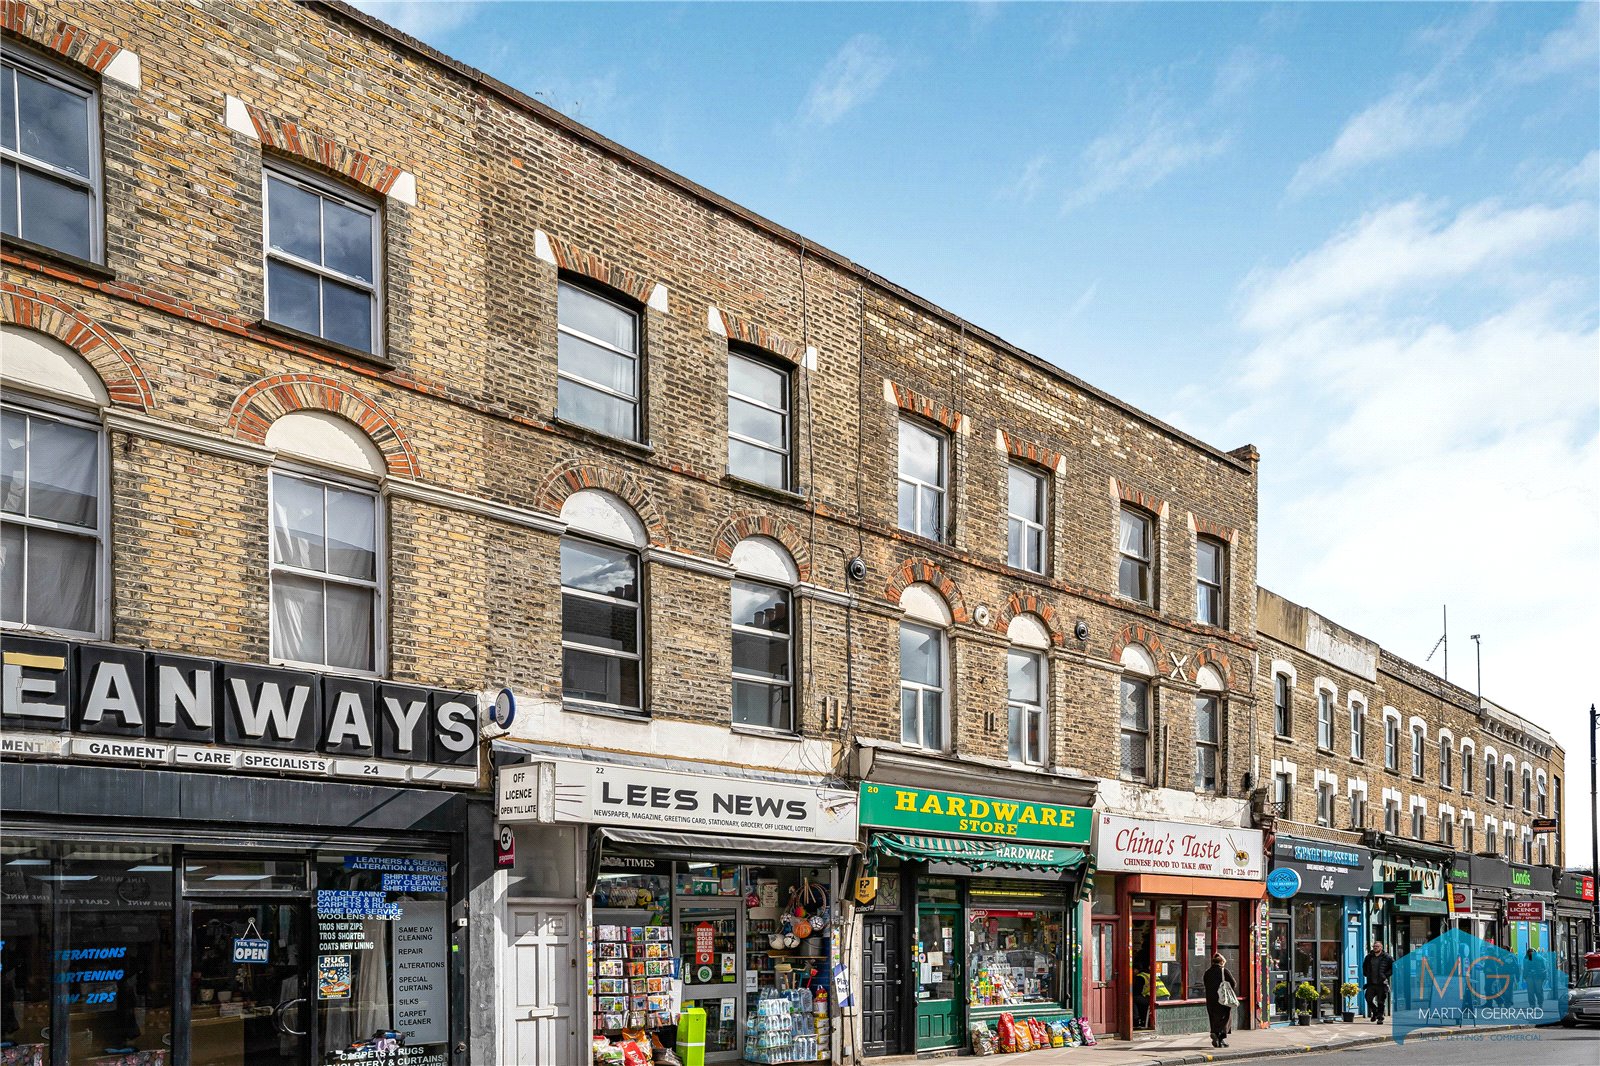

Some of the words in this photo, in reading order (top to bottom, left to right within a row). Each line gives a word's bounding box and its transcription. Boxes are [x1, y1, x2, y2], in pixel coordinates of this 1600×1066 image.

[89, 743, 166, 759] GARMENT
[193, 752, 231, 764] CARE
[245, 755, 326, 771] SPECIALISTS
[363, 765, 379, 775] 24
[513, 772, 525, 783] OFF
[505, 788, 532, 800] LICENCE
[867, 786, 879, 794] 20
[602, 781, 699, 811] LEES
[712, 792, 807, 820] NEWS
[500, 806, 513, 815] OPEN
[514, 805, 524, 814] TILL
[524, 804, 537, 813] LATE
[894, 790, 1076, 828] HARDWARE
[593, 809, 631, 820] NEWSPAPER,
[632, 812, 664, 822] MAGAZINE,
[664, 814, 690, 824] GREETING
[691, 817, 707, 825] CARD,
[708, 819, 740, 828] STATIONARY,
[774, 824, 794, 832] LICENCE,
[959, 819, 1018, 836] STORE
[1115, 827, 1175, 856] China's
[1181, 834, 1221, 859] Taste
[996, 846, 1054, 861] HARDWARE
[352, 862, 407, 871] ALTERATION
[356, 856, 402, 865] LEATHERS
[413, 859, 446, 867] SUEDES
[624, 858, 655, 868] TIMES
[1123, 858, 1151, 867] CHINESE
[1152, 860, 1170, 868] FOOD
[1181, 862, 1197, 870] TAKE
[1198, 863, 1213, 871] AWAY
[1320, 875, 1335, 891] Cafe
[1513, 868, 1531, 886] Londis
[339, 890, 387, 898] CLEANING
[318, 923, 335, 931] TROS
[350, 922, 363, 930] ZIPS
[319, 932, 336, 940] TROS
[337, 932, 365, 940] SHORTEN
[319, 942, 339, 950] COATS
[340, 942, 353, 950] NEW
[354, 941, 374, 950] LINING
[235, 947, 267, 960] OPEN
[398, 961, 445, 969] ALTERATIONS
[86, 991, 117, 1005] ZIPS
[399, 1018, 431, 1026] CLEANER
[340, 1049, 387, 1061] CARPETS
[388, 1048, 395, 1057] &
[397, 1046, 424, 1056] RUGS
[388, 1056, 395, 1066] &
[397, 1054, 444, 1065] CURTAINS
